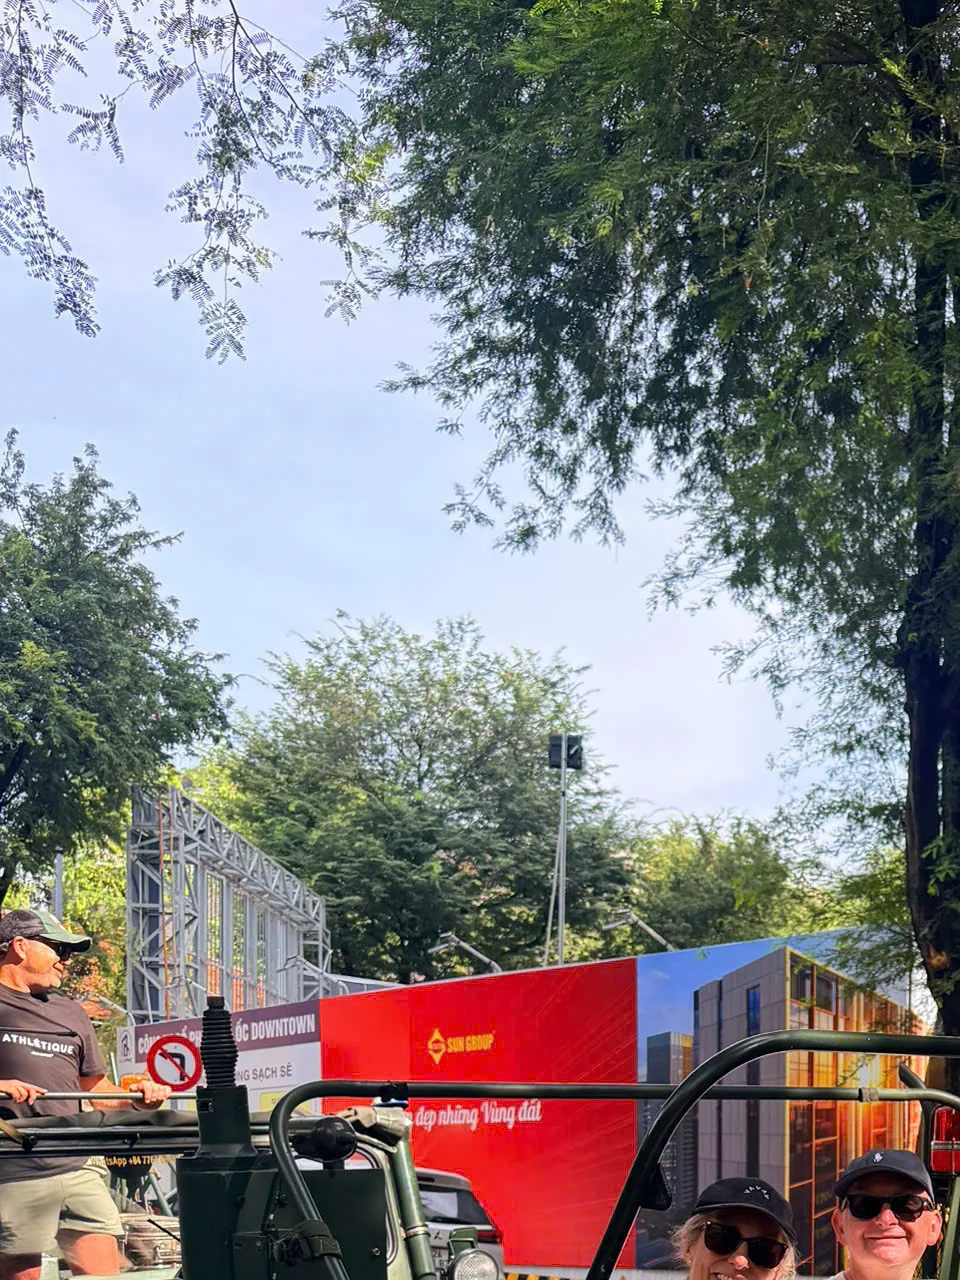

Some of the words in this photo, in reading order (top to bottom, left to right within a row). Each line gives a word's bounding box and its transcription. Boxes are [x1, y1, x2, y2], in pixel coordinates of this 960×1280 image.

[251, 1013, 316, 1040] DOWNTOWN
[447, 1036, 465, 1053] SUN
[466, 1033, 495, 1052] GROUP
